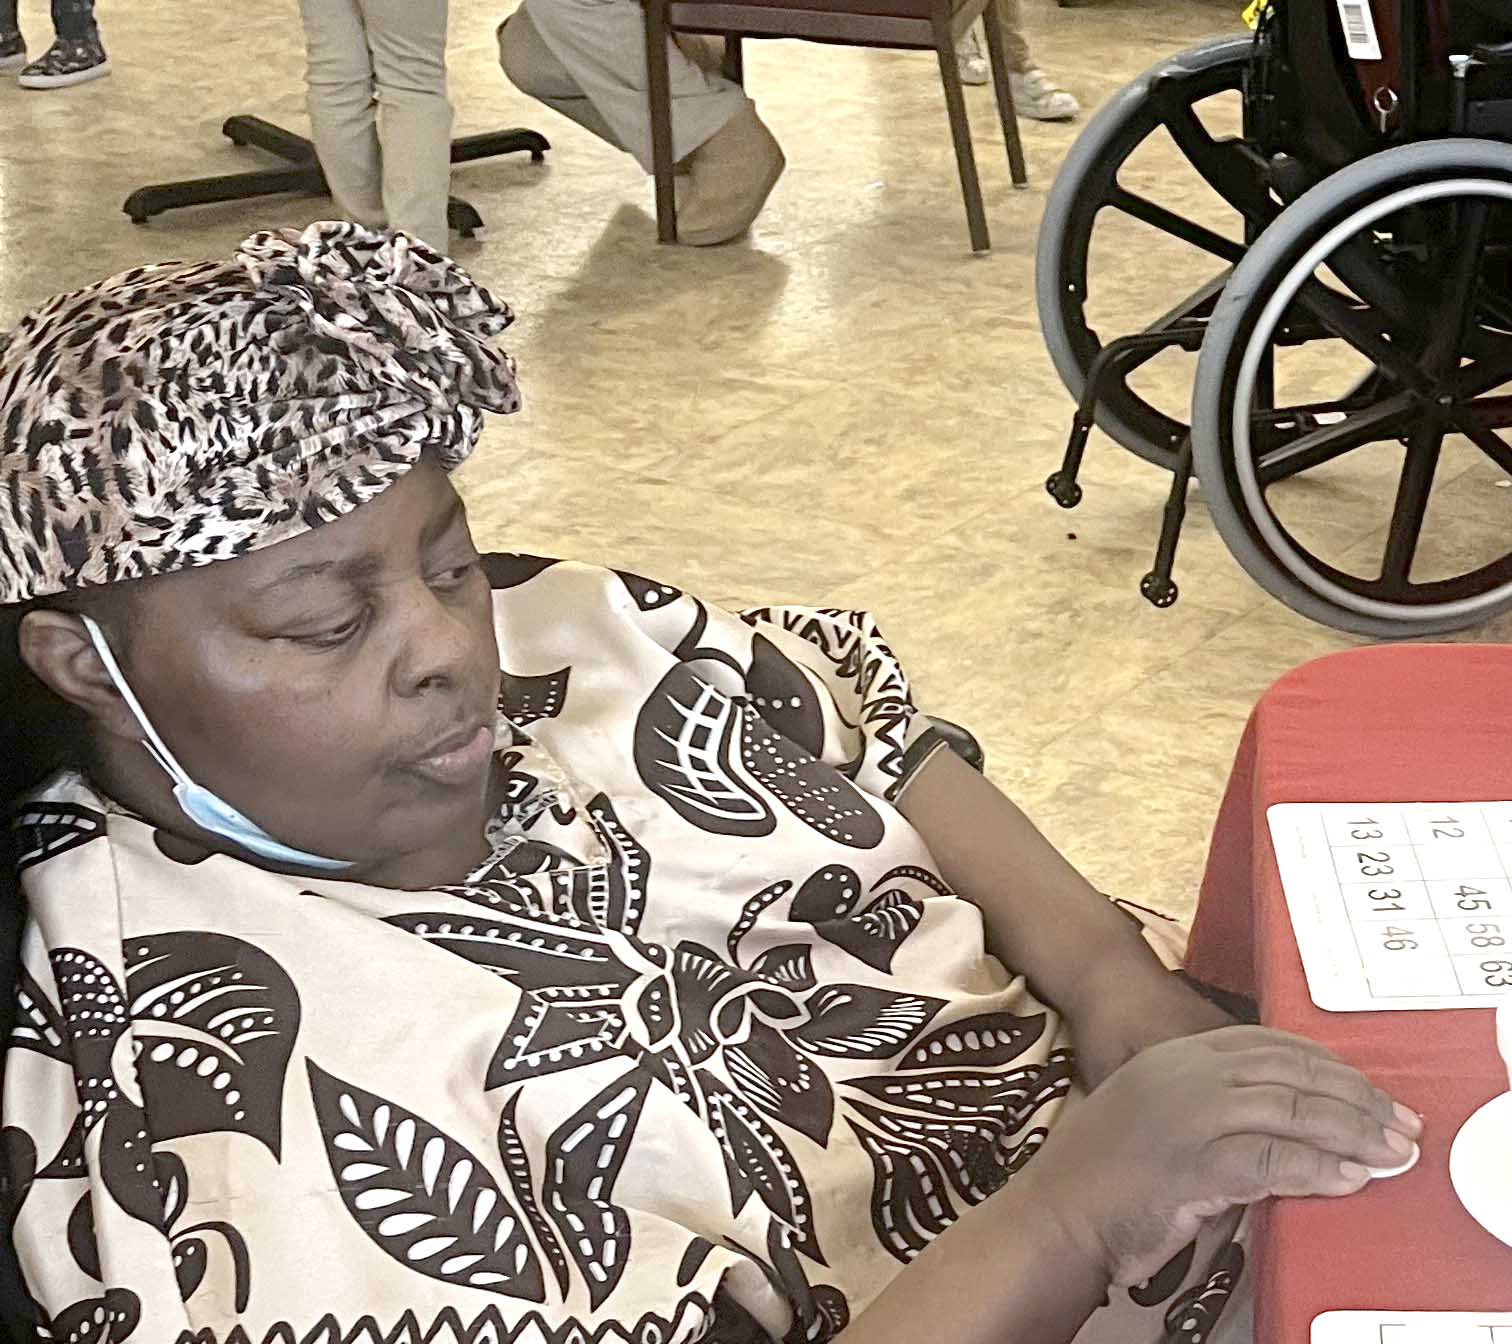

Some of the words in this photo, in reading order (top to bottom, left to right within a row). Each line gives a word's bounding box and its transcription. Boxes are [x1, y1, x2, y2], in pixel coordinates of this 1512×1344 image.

[1347, 817, 1384, 841] 13
[1430, 817, 1465, 839] 12
[1356, 851, 1395, 877] 23
[1367, 888, 1407, 912] 31
[1453, 884, 1493, 912] 45
[1380, 925, 1420, 952] 46
[1464, 923, 1506, 949] 58
